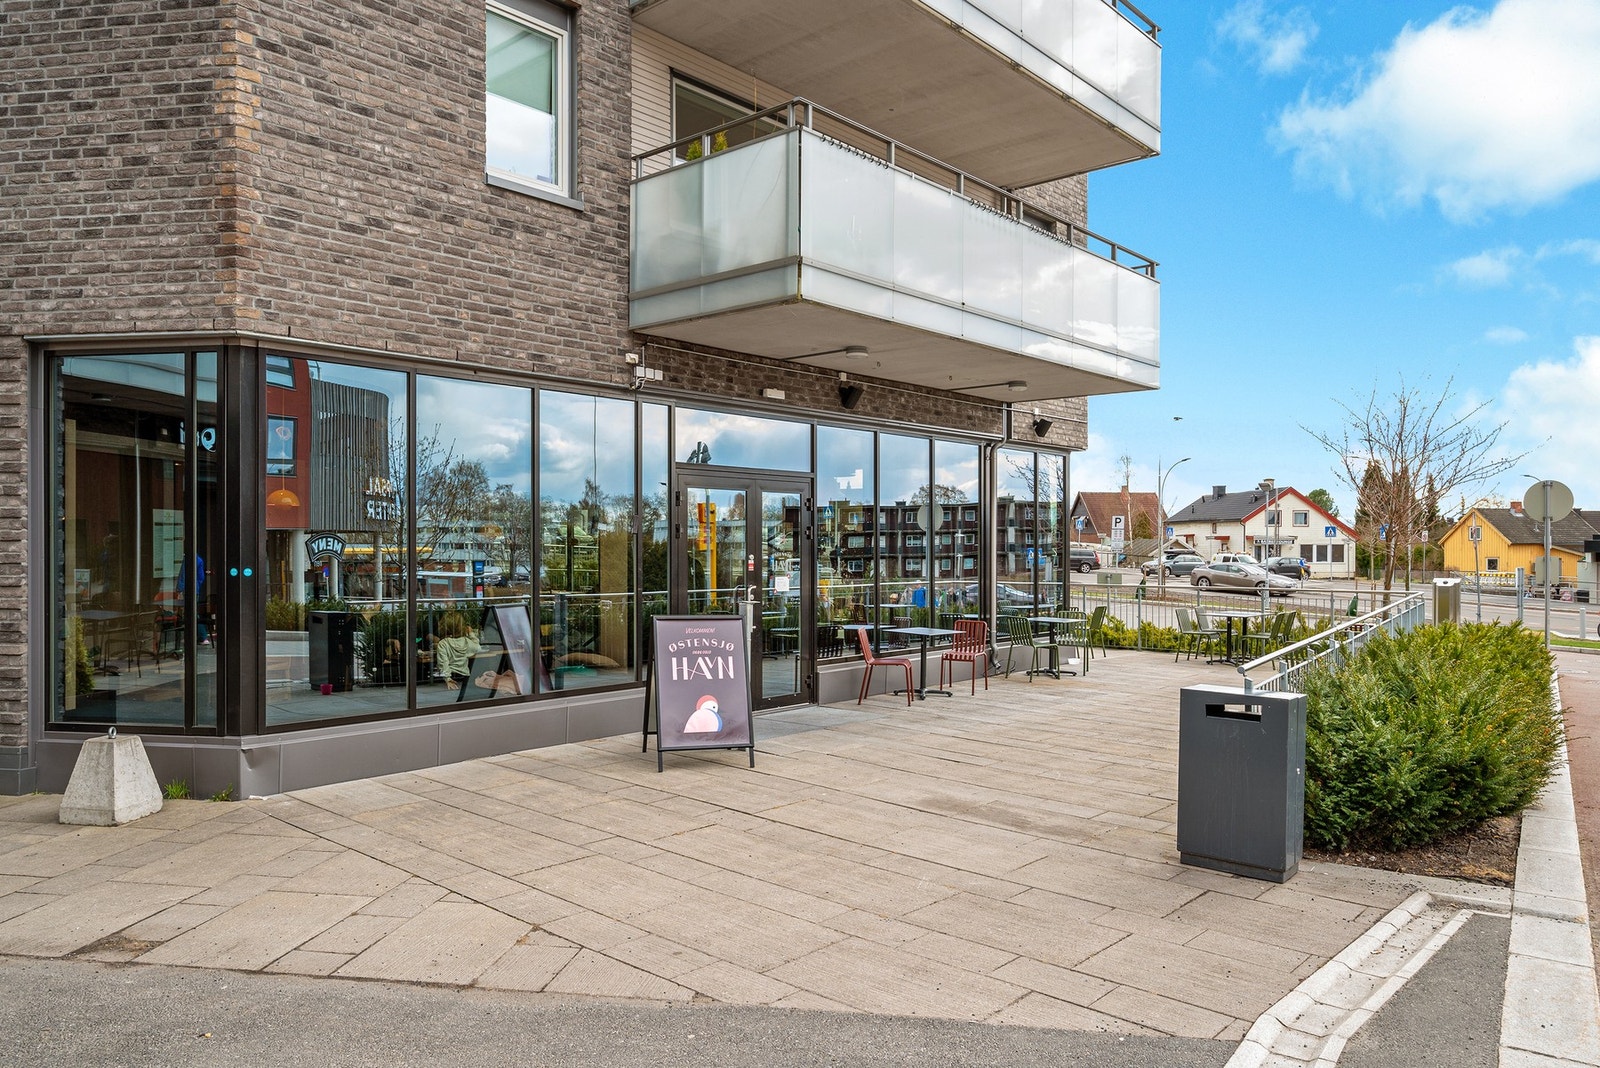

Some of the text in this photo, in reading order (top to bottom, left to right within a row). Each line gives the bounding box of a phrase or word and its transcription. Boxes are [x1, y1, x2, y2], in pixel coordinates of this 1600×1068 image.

[1115, 517, 1122, 528] P
[668, 638, 735, 653] ØSTENSJØ
[671, 655, 735, 681] HAVN
